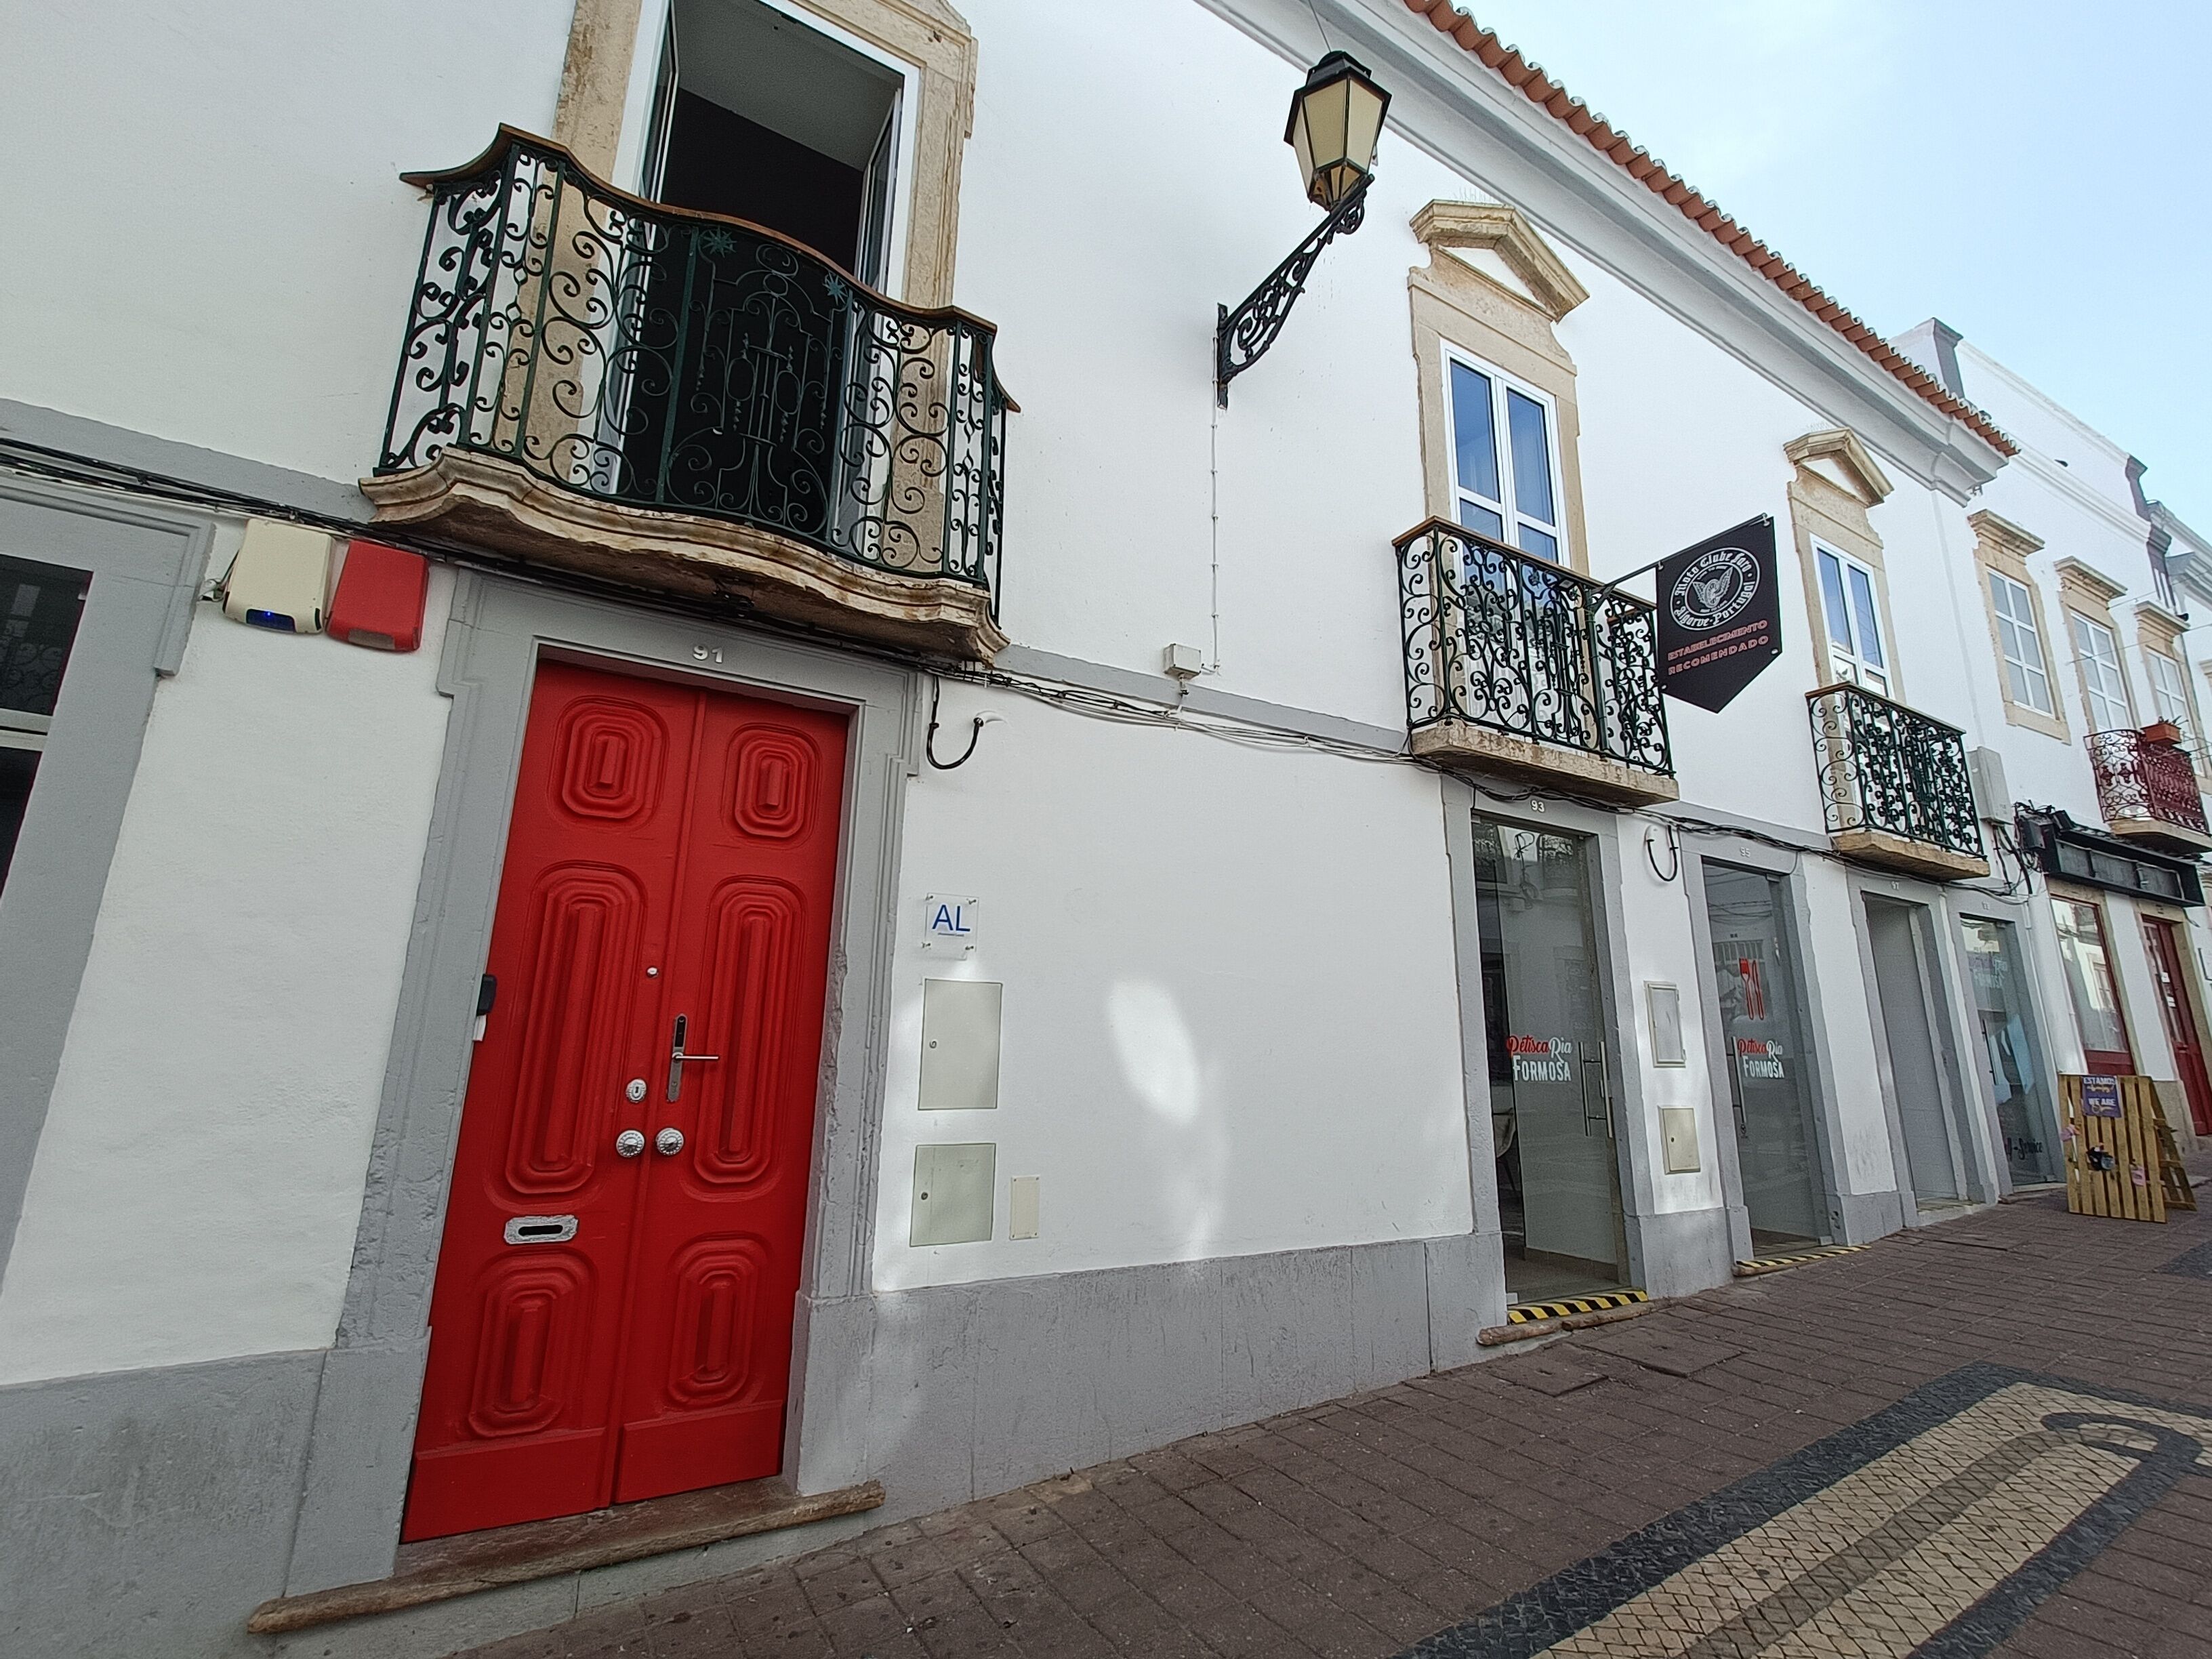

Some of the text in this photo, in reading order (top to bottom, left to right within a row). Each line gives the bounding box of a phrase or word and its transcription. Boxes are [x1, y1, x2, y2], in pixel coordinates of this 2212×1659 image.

[1674, 566, 1700, 596] Moto
[1700, 551, 1734, 568] Clube
[693, 645, 723, 663] 91
[1667, 635, 1769, 676] RECOMENDADO
[1531, 800, 1545, 813] 93
[932, 904, 971, 933] AL
[1512, 1054, 1572, 1082] FORMOSA
[1742, 1055, 1785, 1079] FORMOSA
